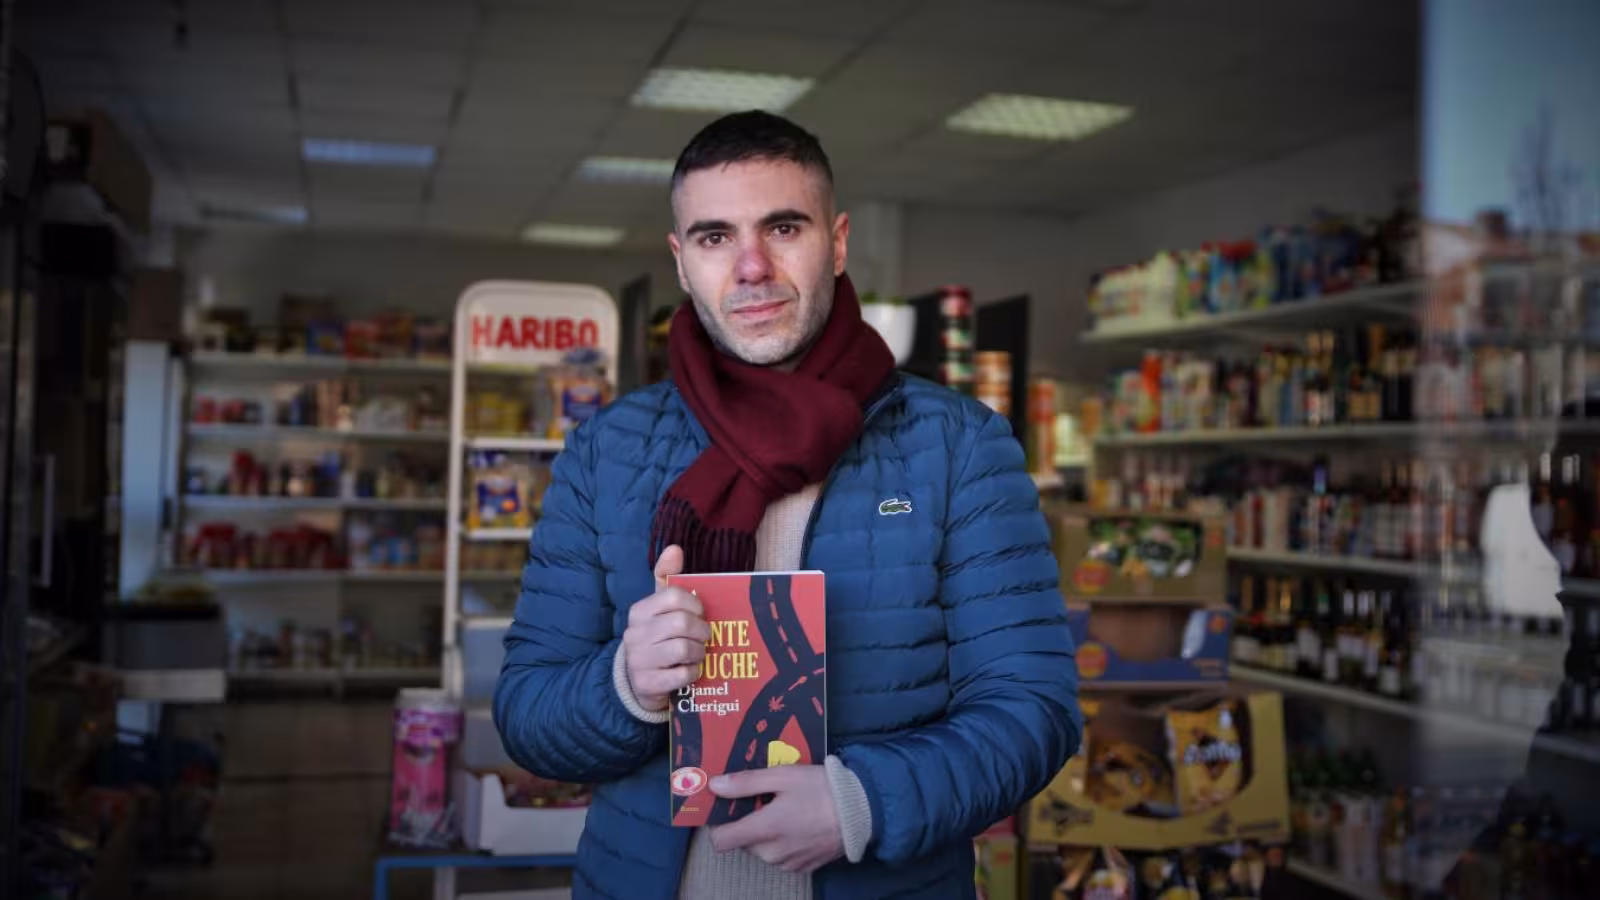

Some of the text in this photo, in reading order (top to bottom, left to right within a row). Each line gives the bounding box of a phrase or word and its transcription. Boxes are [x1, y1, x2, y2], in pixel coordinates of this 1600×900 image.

[471, 315, 599, 350] HARIBO
[705, 620, 750, 647] NTE
[677, 682, 729, 698] Djamel
[677, 698, 740, 716] Cherigui
